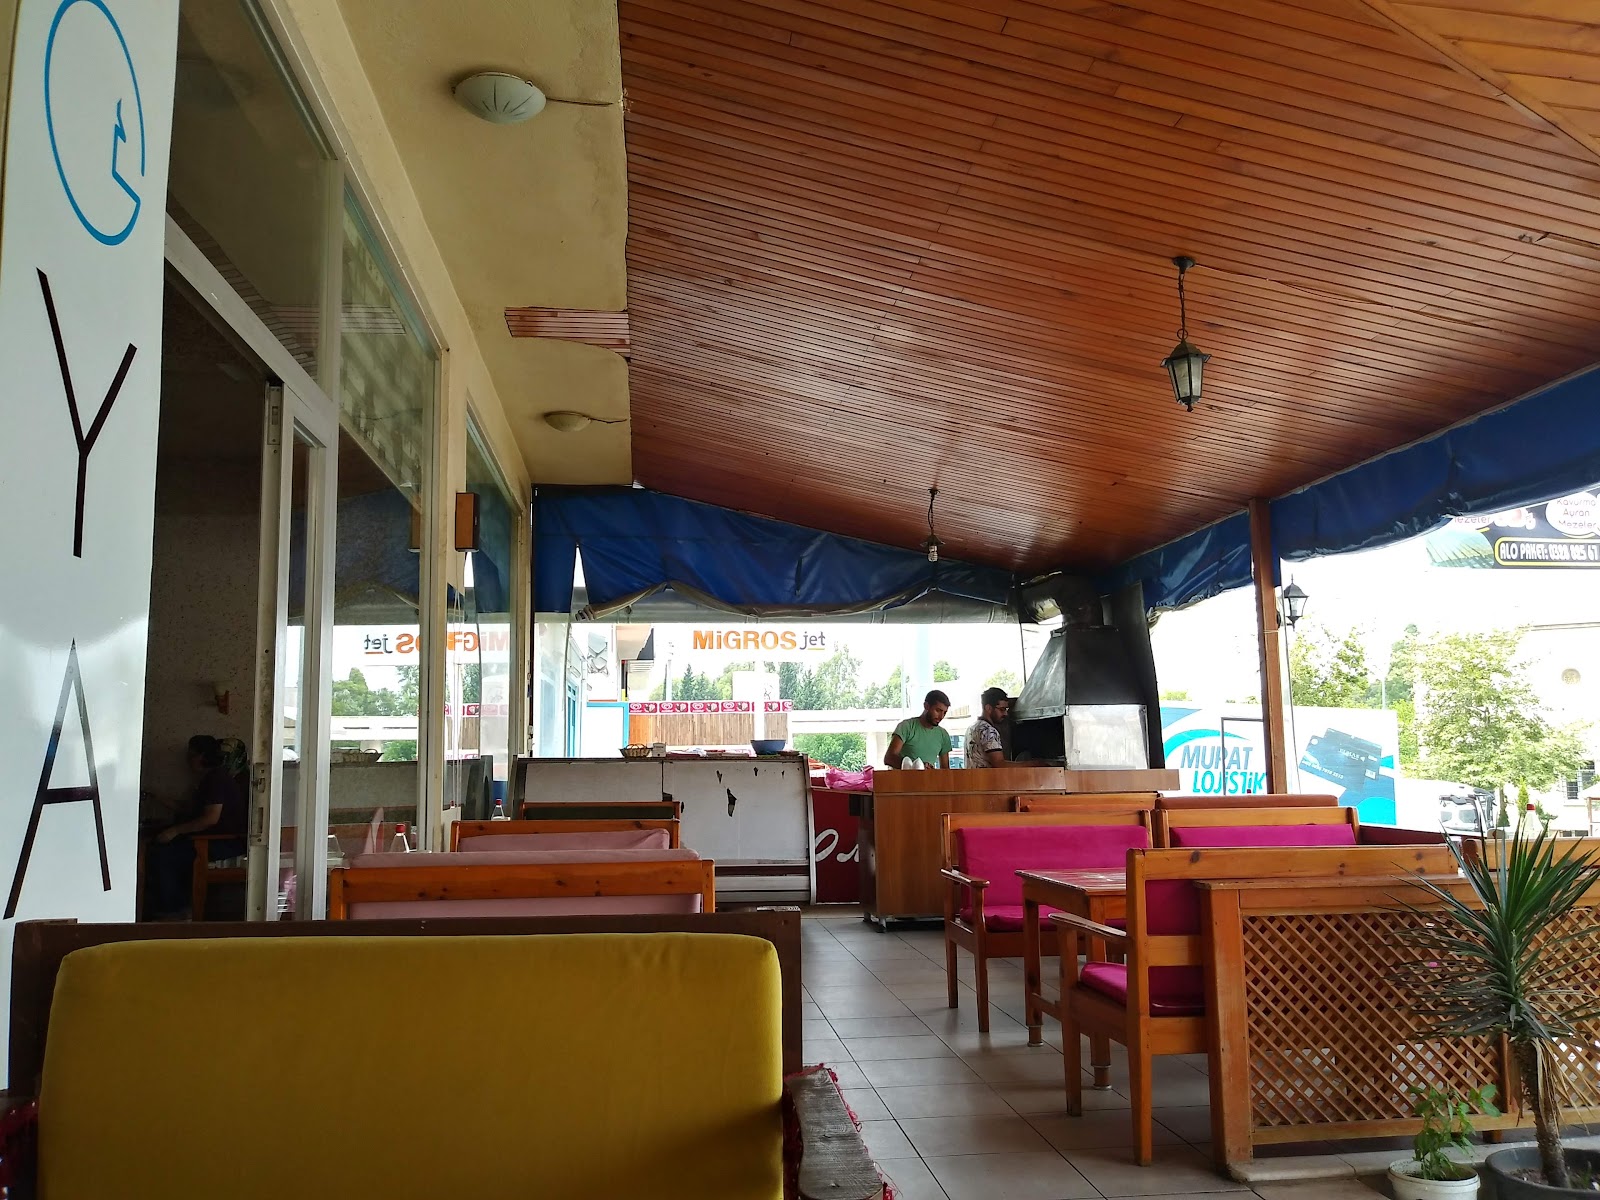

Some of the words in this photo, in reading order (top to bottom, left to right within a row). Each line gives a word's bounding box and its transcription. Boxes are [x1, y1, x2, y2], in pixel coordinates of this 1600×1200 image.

[1500, 543, 1518, 560] ALO
[693, 630, 797, 651] MiGROS
[799, 631, 826, 651] jet
[1180, 745, 1253, 770] MURAT
